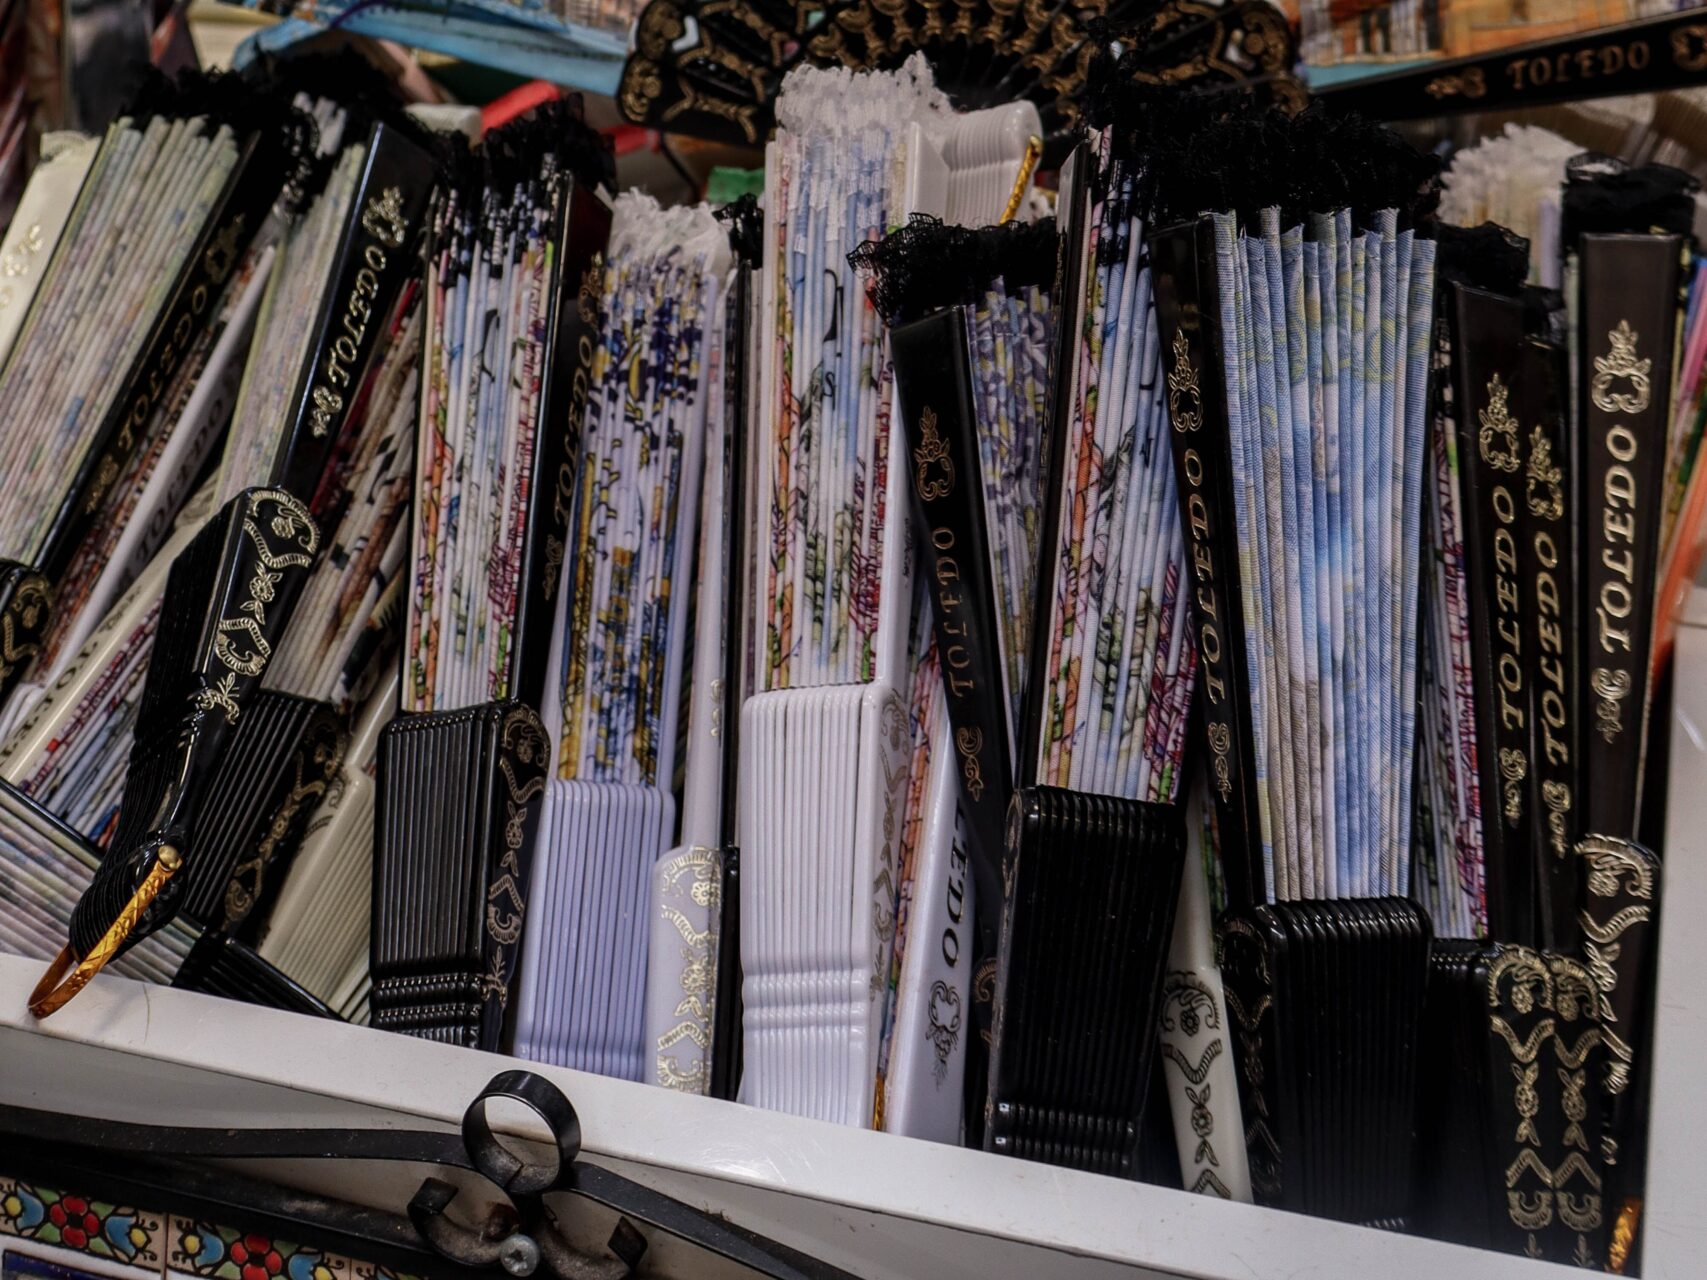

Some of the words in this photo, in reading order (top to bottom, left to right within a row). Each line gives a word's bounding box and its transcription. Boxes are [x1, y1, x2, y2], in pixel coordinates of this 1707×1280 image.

[1506, 41, 1650, 90] TOLEDO
[328, 245, 387, 387] TOLEDO
[554, 335, 592, 526] TOLEDO
[1185, 448, 1225, 705] TOLEDO
[1493, 485, 1524, 730] TOLEDO
[1534, 530, 1569, 765] TOLEDO
[1596, 425, 1638, 654] TOLEDO
